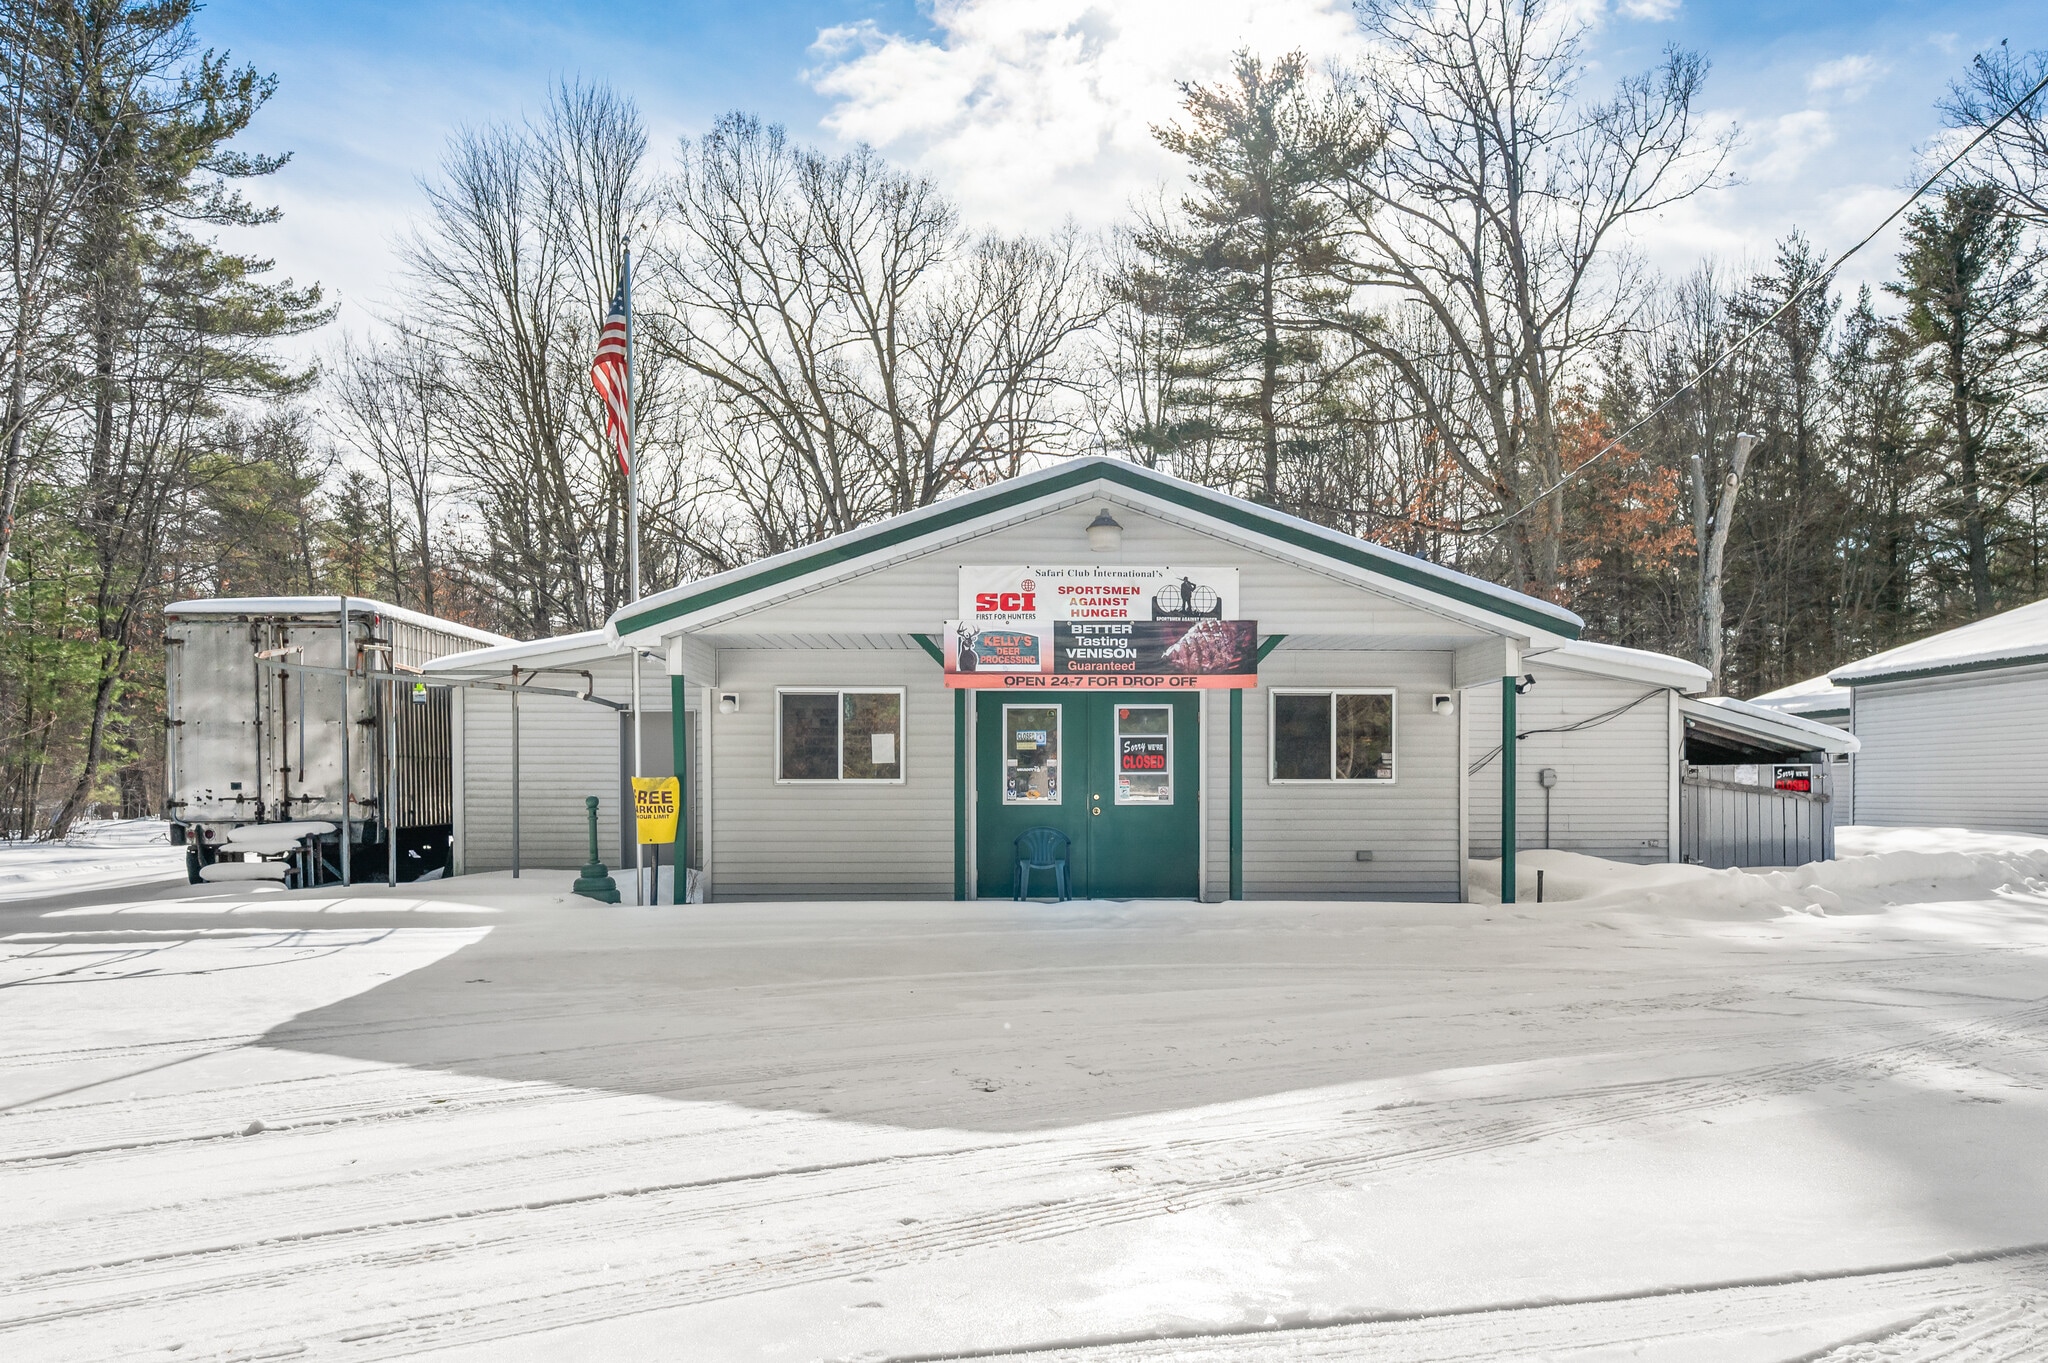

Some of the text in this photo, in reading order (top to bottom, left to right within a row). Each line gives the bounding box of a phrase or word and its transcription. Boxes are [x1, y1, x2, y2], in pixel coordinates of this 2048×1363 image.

[1035, 569, 1163, 578] Safari Club International's
[1058, 586, 1140, 595] SPORTSMEN
[976, 592, 1036, 612] SCI
[1069, 597, 1129, 606] AGAINST
[1070, 609, 1128, 618] HUNGER
[1071, 624, 1133, 634] BETTER
[983, 636, 1032, 647] KELLY'S
[1075, 636, 1128, 649] Tasting
[996, 647, 1020, 656] DEER
[1065, 648, 1137, 659] VENISON
[980, 656, 1036, 664] PROCESSING
[1067, 661, 1136, 671] Guaranteed
[1004, 676, 1198, 687] OPEN 24-7 FOR DROP OFF
[1124, 741, 1146, 753] Sorry
[1123, 754, 1165, 769] CLOSED
[1777, 769, 1795, 779] Sorry
[1776, 779, 1810, 791] CLOSED
